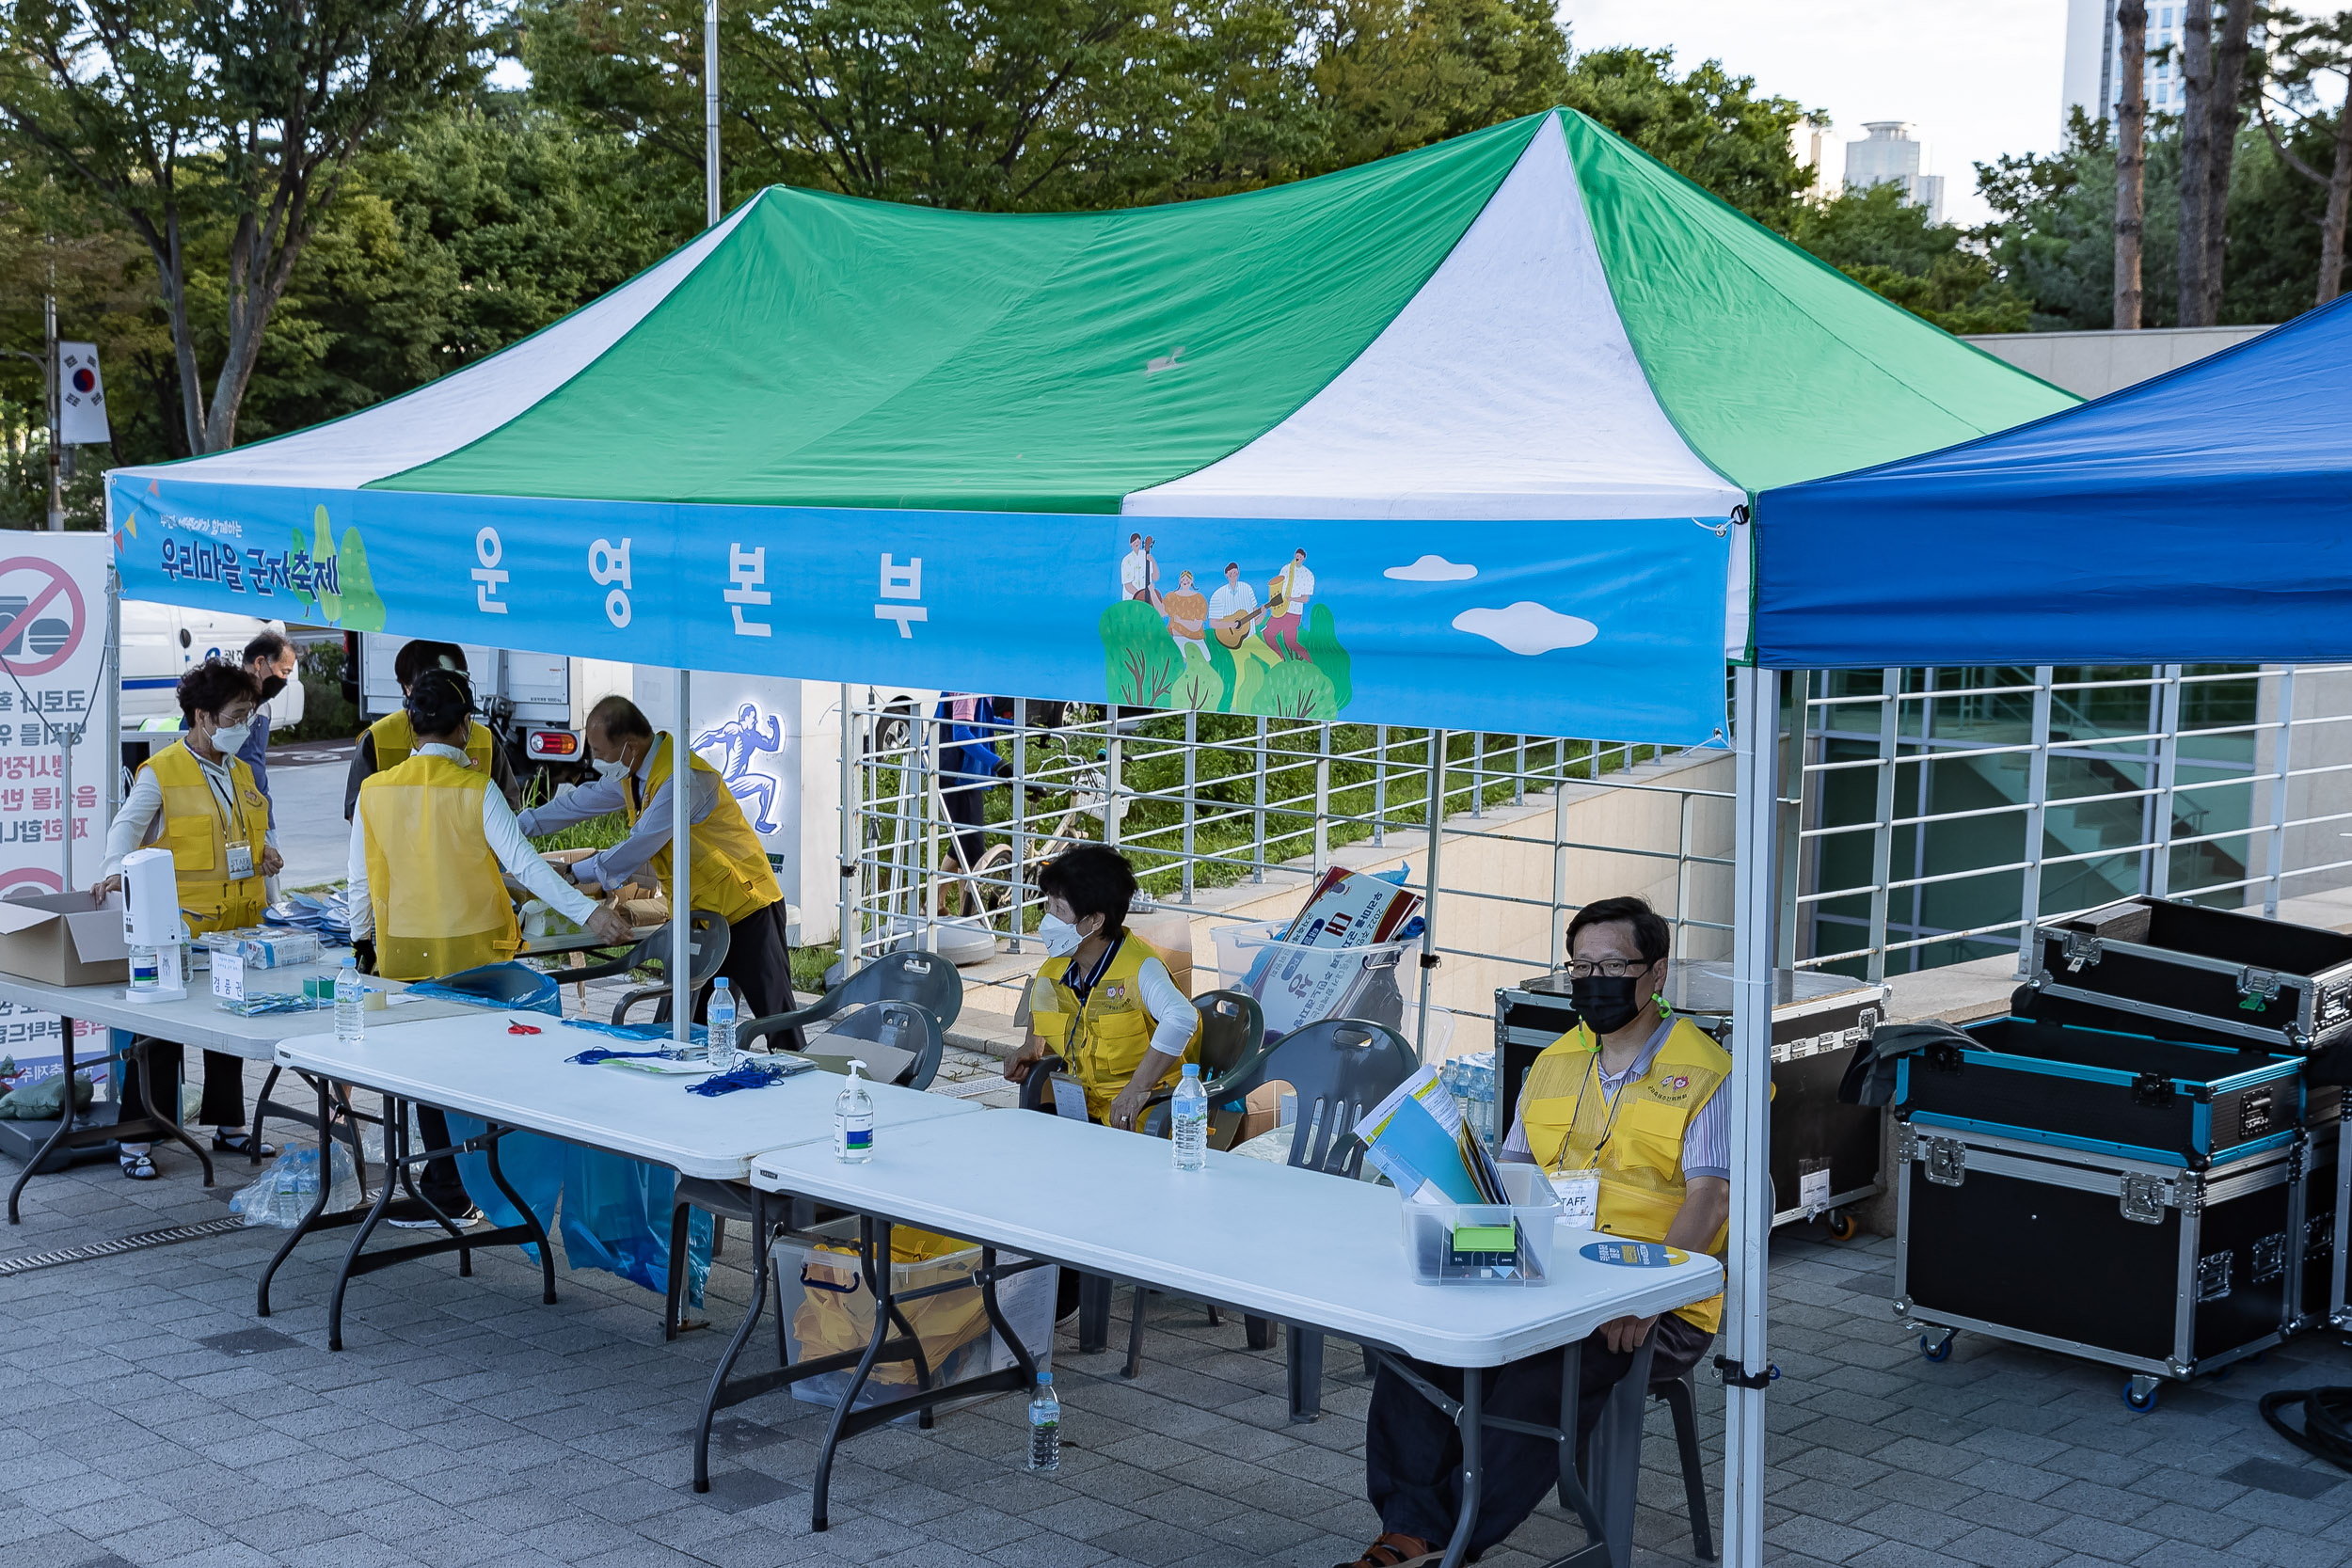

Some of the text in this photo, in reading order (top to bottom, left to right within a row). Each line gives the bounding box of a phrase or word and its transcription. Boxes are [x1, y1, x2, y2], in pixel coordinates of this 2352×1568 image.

[211, 519, 243, 538] 함께하는
[162, 537, 343, 602] 우리마을 군자축제
[1355, 892, 1383, 929] 우리마을
[1367, 908, 1384, 930] 2022
[1287, 911, 1353, 999] 대 상
[1288, 958, 1299, 972] PC
[1311, 988, 1334, 1019] 함께하는
